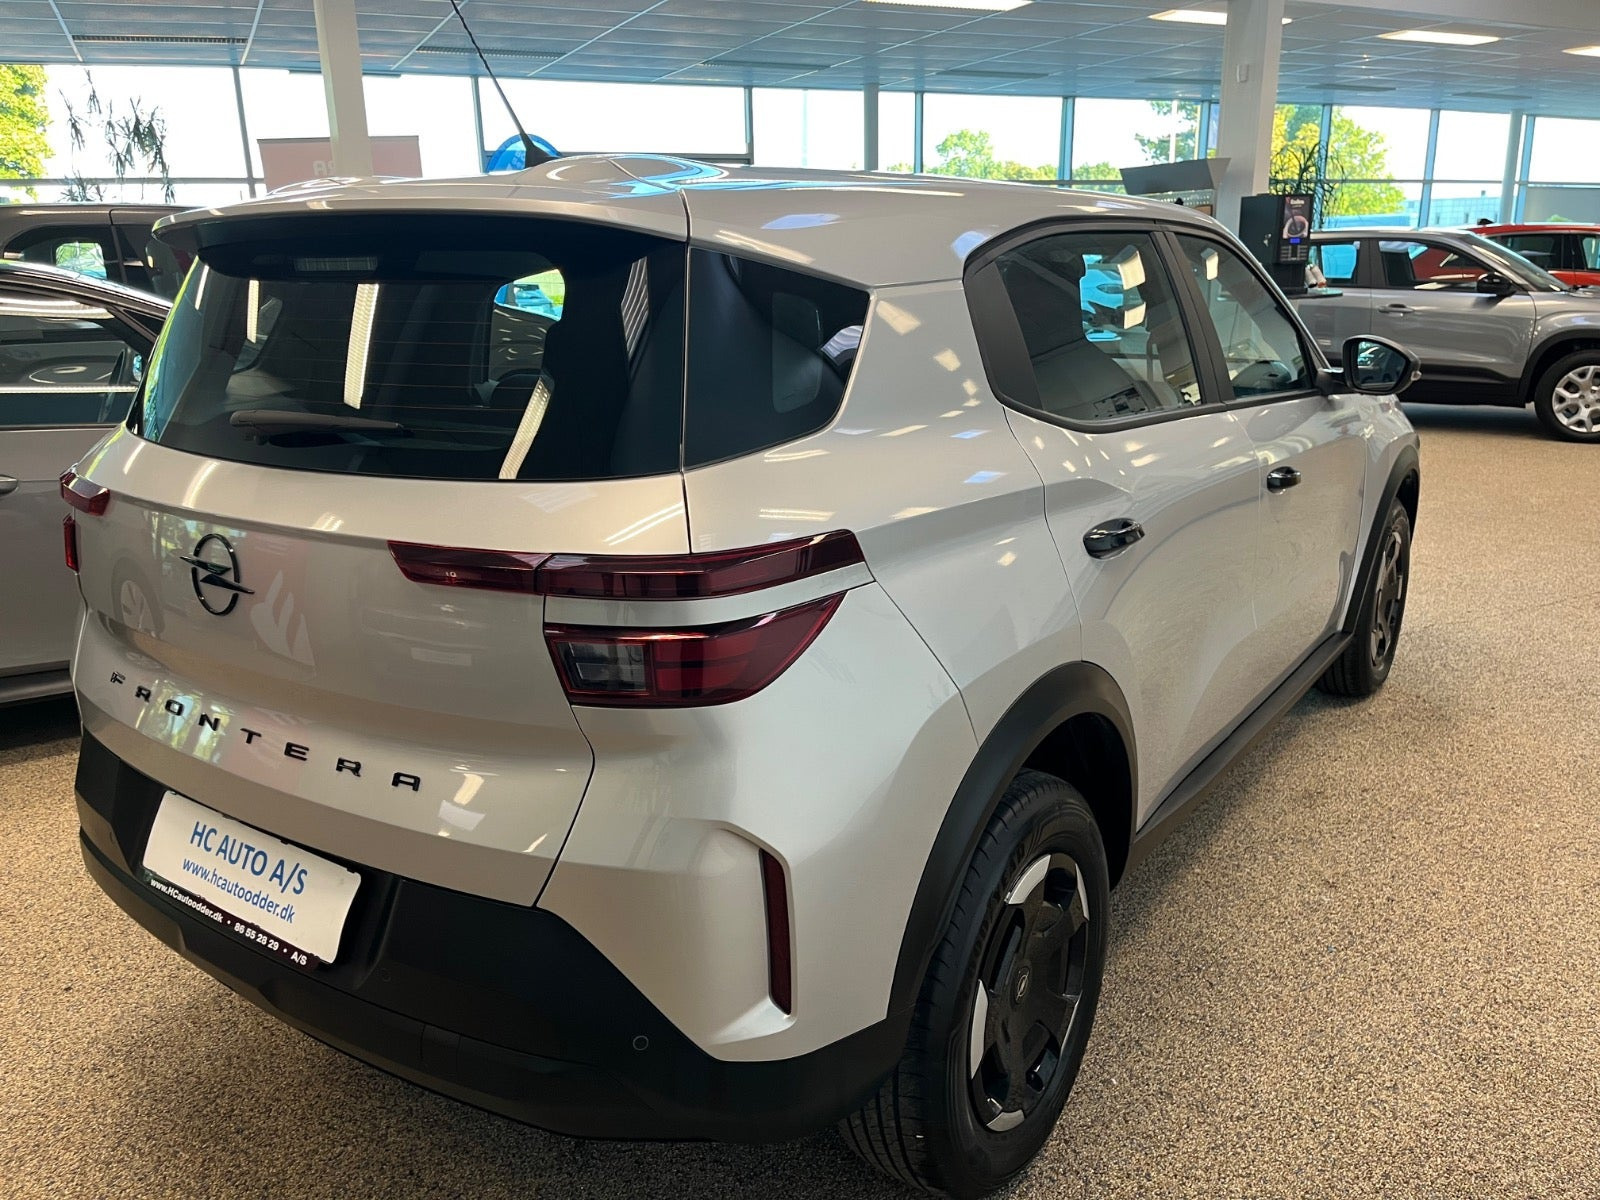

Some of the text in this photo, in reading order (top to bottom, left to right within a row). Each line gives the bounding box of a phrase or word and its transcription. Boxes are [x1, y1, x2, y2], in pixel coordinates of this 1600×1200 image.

[110, 671, 421, 792] FRONTERA
[182, 858, 296, 924] www.hcautoodder.dk
[190, 821, 308, 895] HC AUTO A/S
[150, 877, 308, 966] www.HCautoodder.dk 86 55 28 29 A/S
